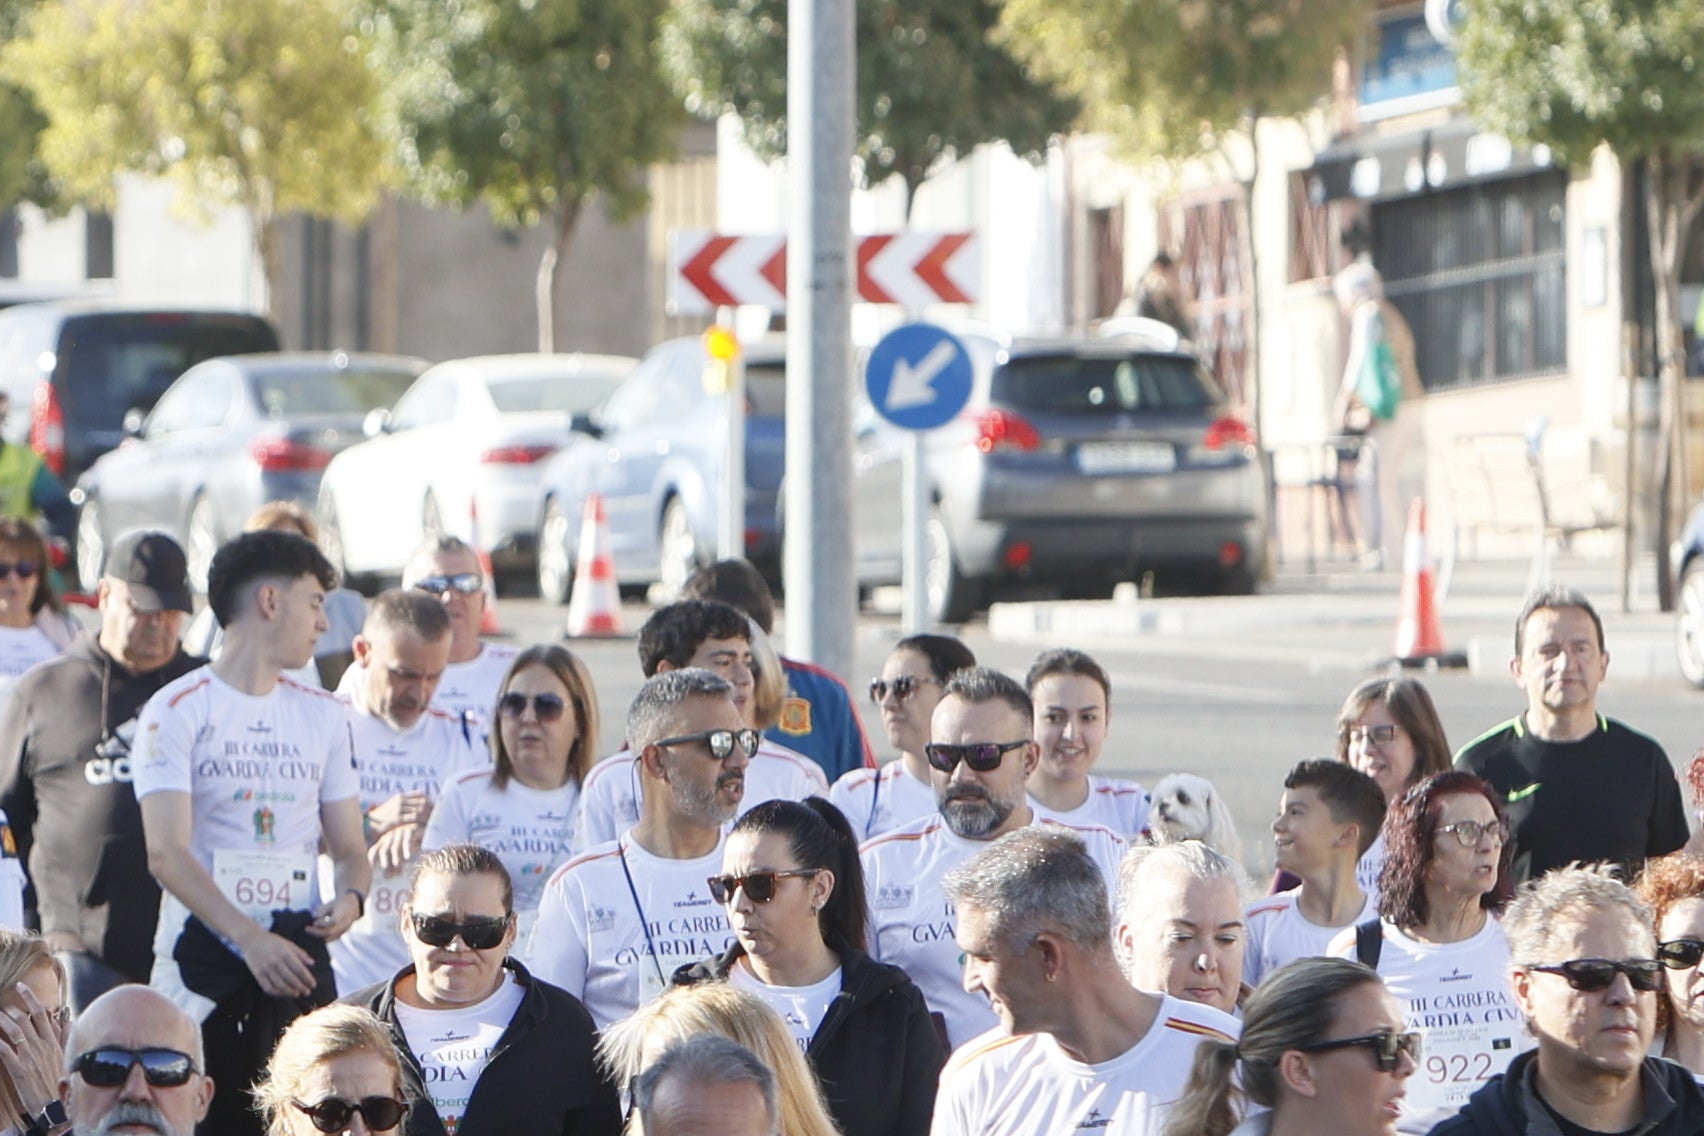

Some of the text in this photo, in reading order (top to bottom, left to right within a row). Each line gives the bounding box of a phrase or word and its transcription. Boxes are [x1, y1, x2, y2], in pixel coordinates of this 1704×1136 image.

[236, 877, 292, 906] 694
[1433, 990, 1508, 1010] CARRERA
[1426, 1052, 1493, 1083] 922
